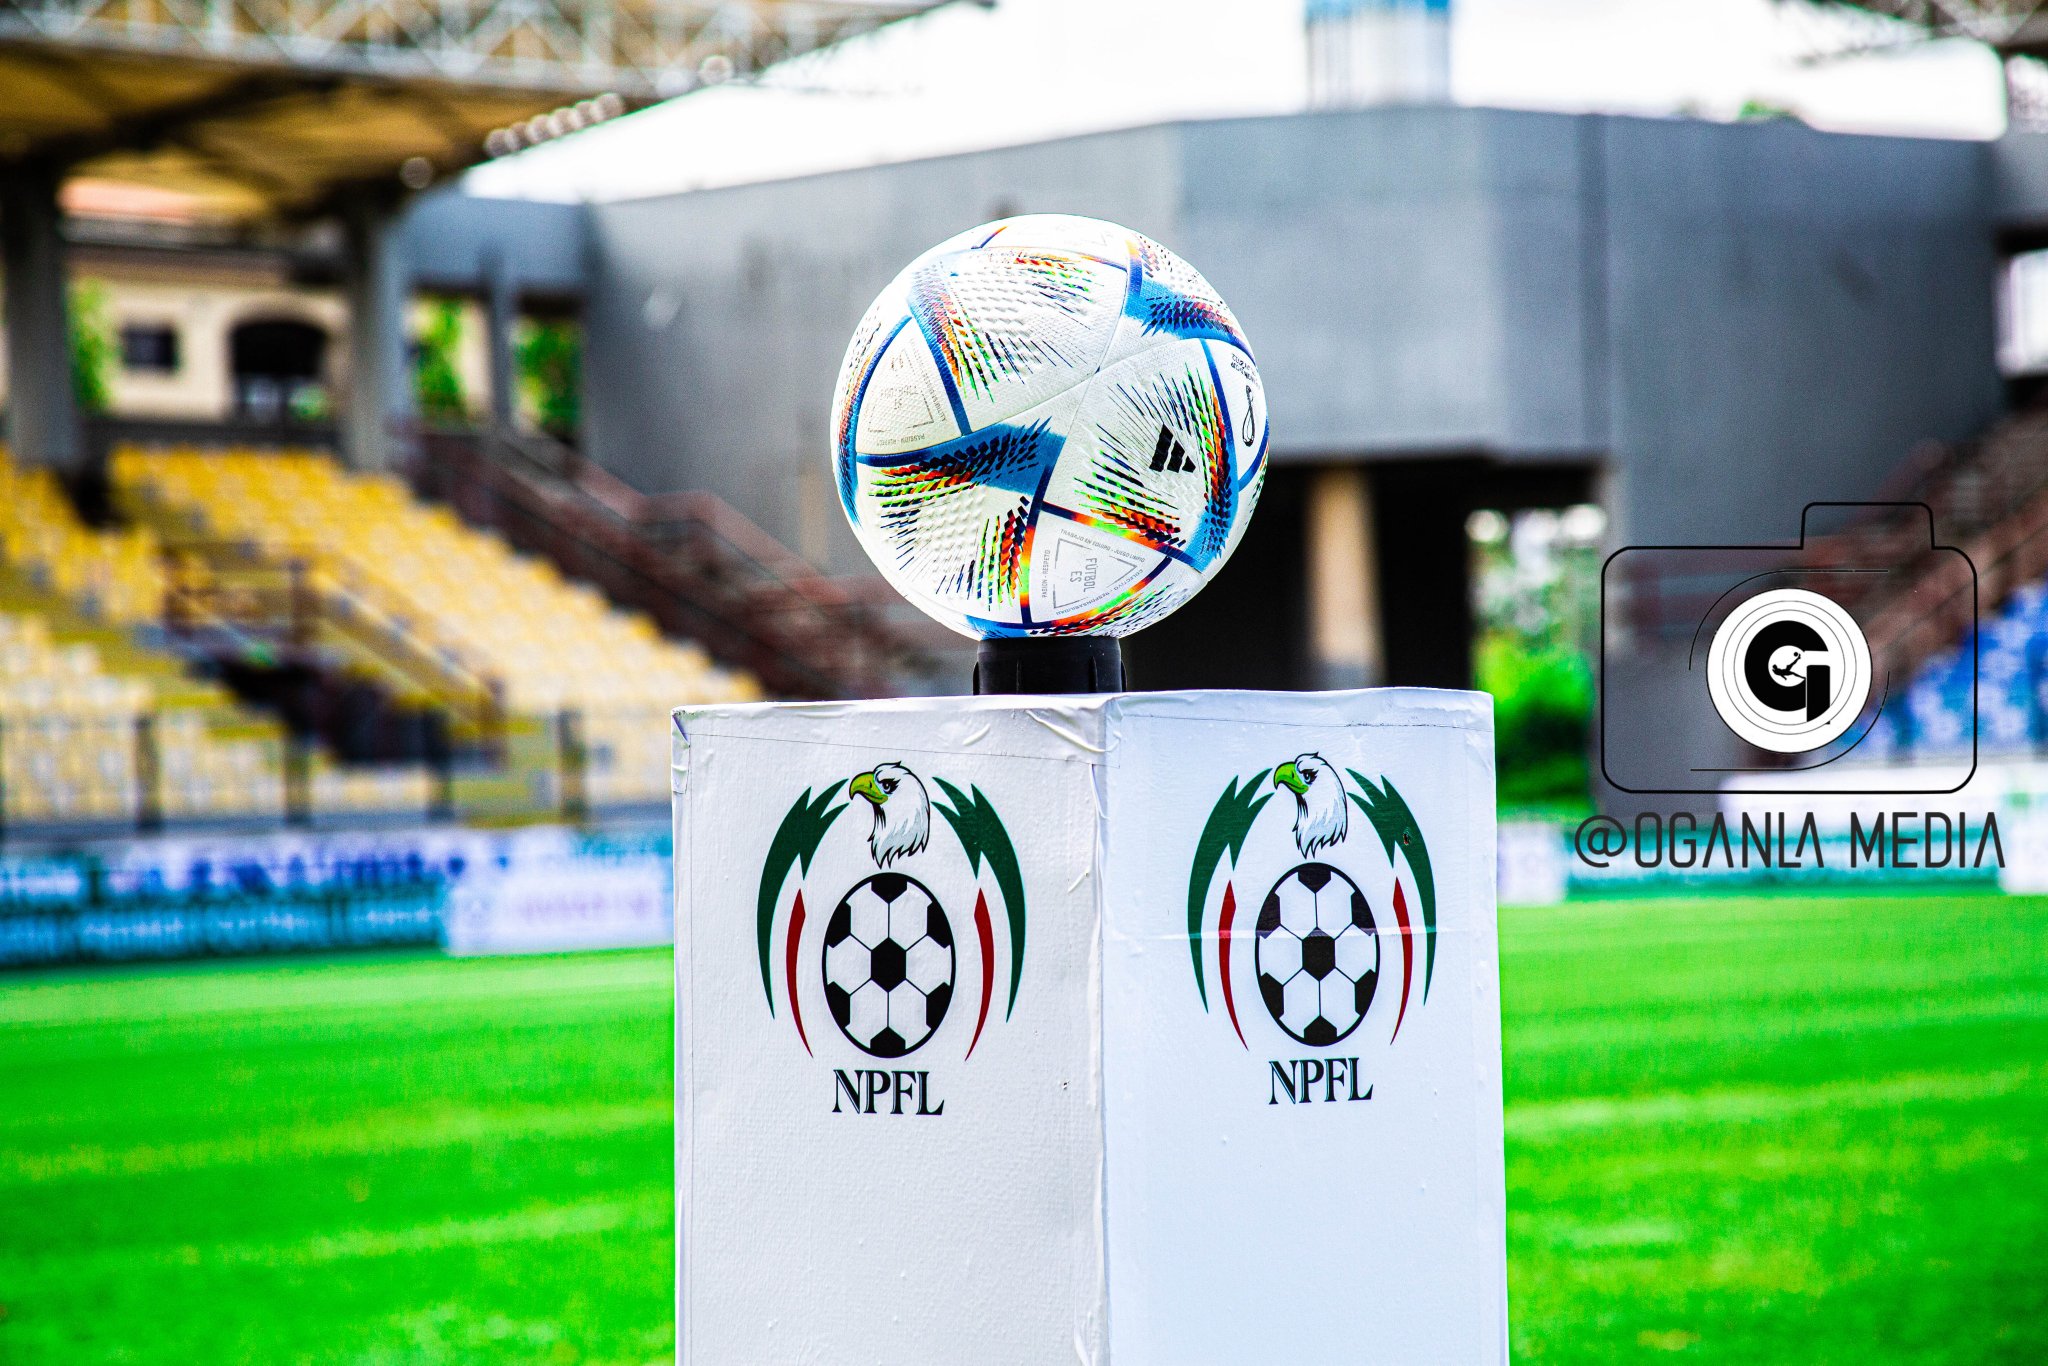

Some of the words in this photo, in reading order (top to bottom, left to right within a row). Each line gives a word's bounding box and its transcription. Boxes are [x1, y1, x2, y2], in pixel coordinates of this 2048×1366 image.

[1060, 528, 1084, 541] TRABAJO
[1084, 537, 1092, 545] EN
[1091, 539, 1111, 552] EQUIPO
[1113, 549, 1129, 558] JUEGO
[1042, 549, 1051, 575] RESPETO
[1069, 570, 1083, 583] ES
[1113, 568, 1144, 591] COLECTIVO
[832, 1069, 945, 1116] NPFL
[1268, 1057, 1374, 1105] NPFL
